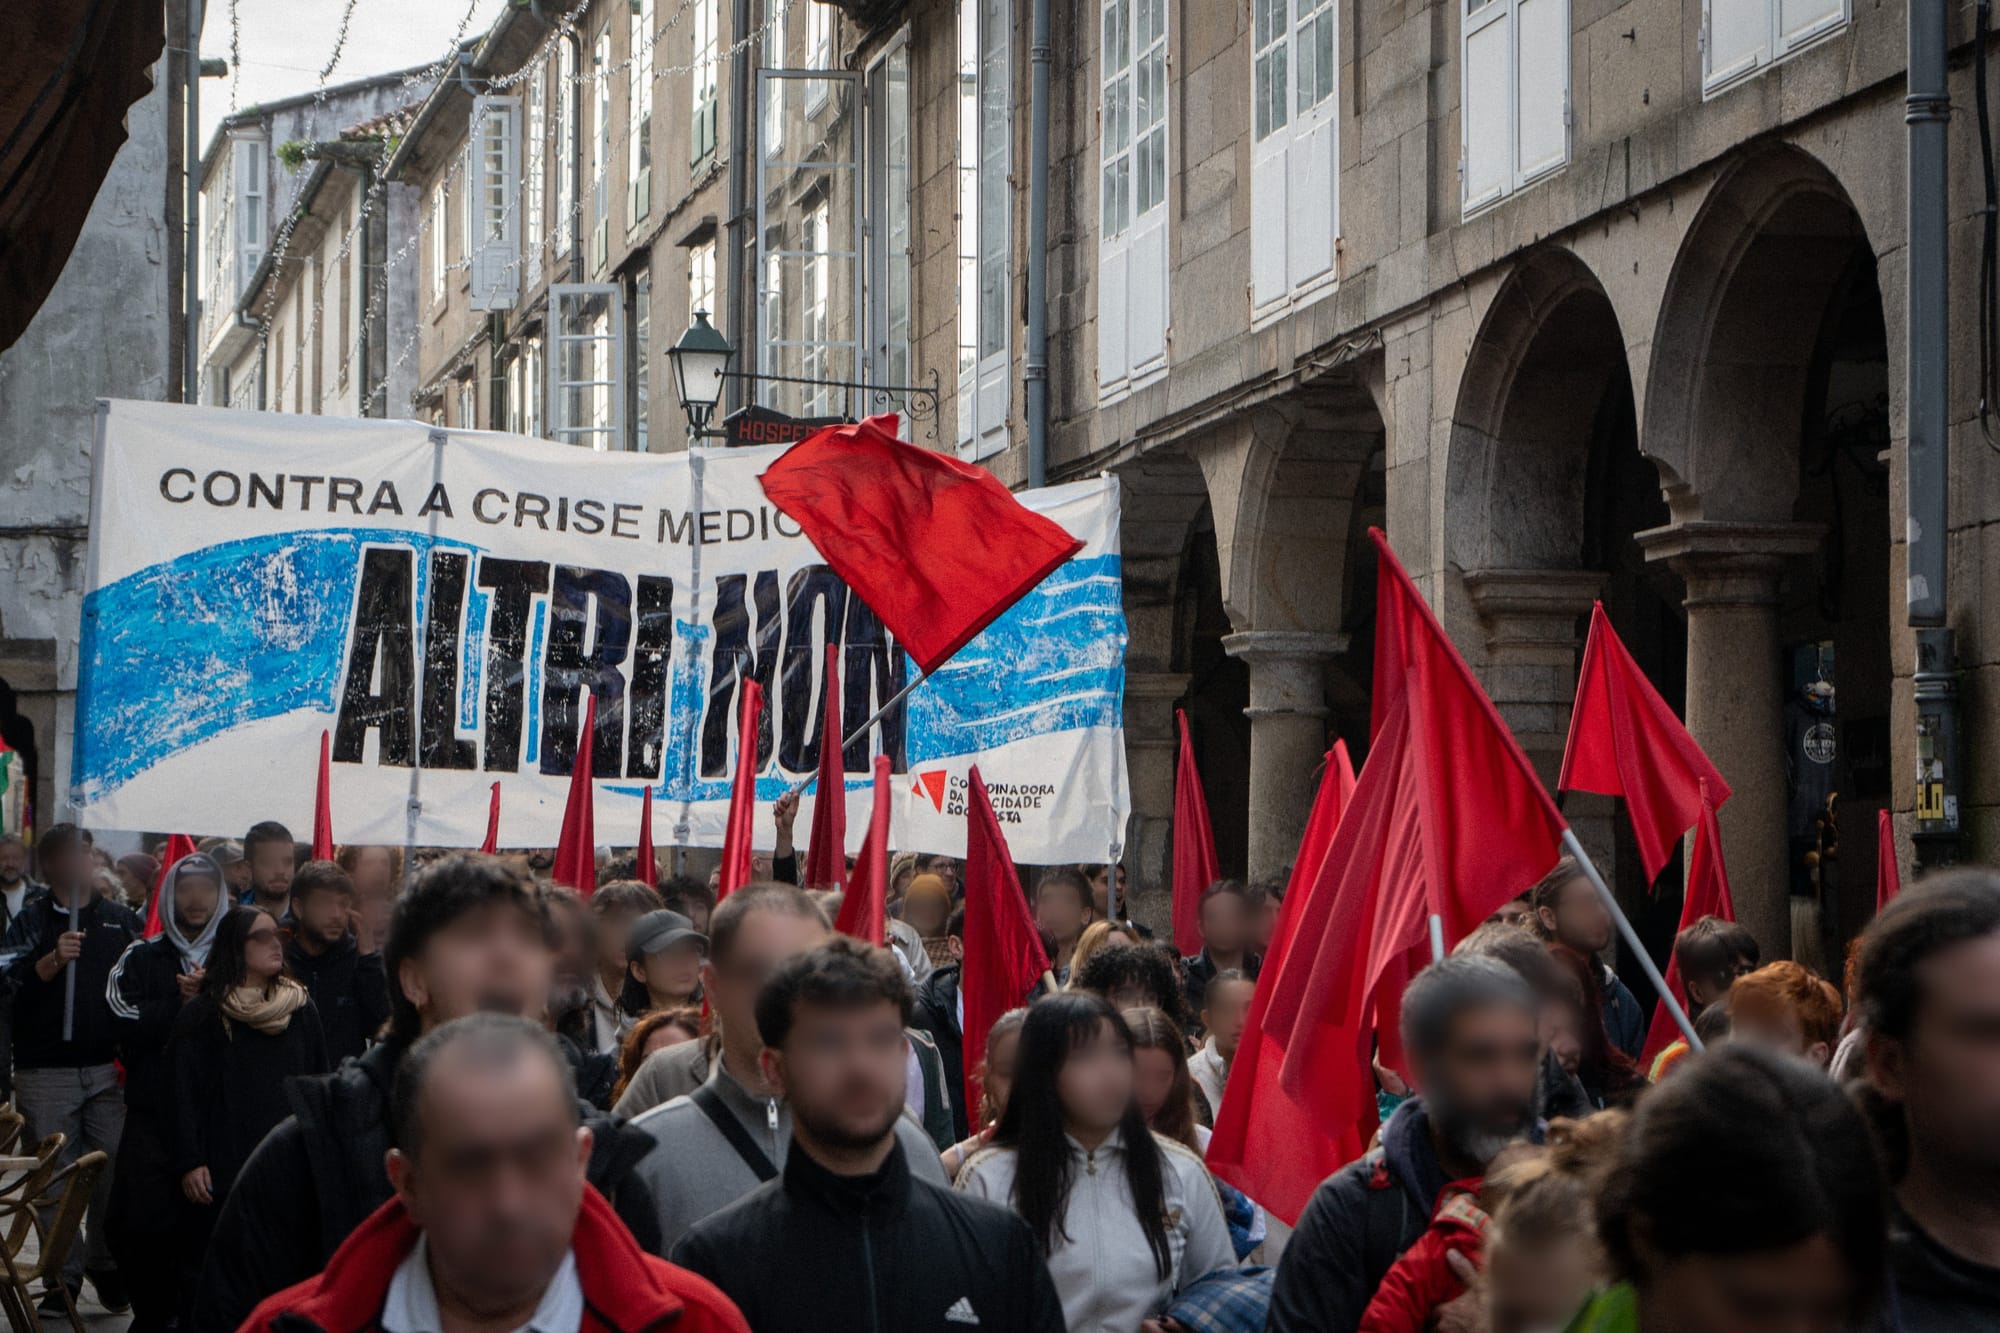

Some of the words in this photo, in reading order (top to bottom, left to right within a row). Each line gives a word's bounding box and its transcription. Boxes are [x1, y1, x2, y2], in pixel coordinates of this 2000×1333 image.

[159, 467, 404, 516] CONTRA
[418, 482, 454, 518] A
[472, 487, 644, 540] CRISE
[332, 547, 674, 779] ALTRI
[949, 789, 964, 804] DA
